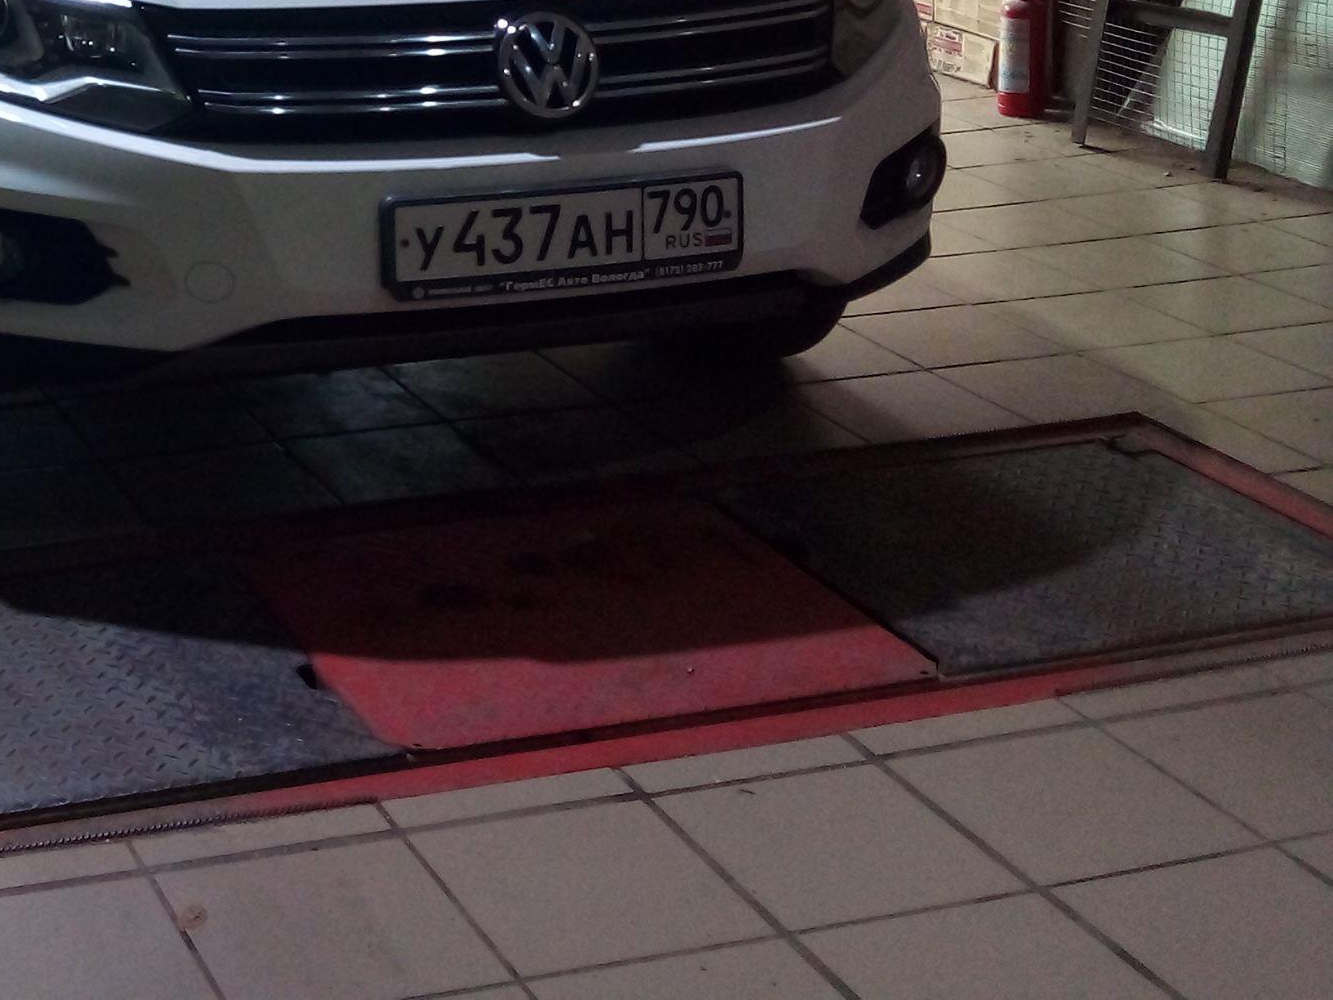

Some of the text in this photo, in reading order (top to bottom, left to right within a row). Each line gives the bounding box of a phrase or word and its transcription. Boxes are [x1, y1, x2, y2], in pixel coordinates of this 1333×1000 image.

[417, 185, 724, 271] У437АН 790
[667, 232, 704, 250] RUS
